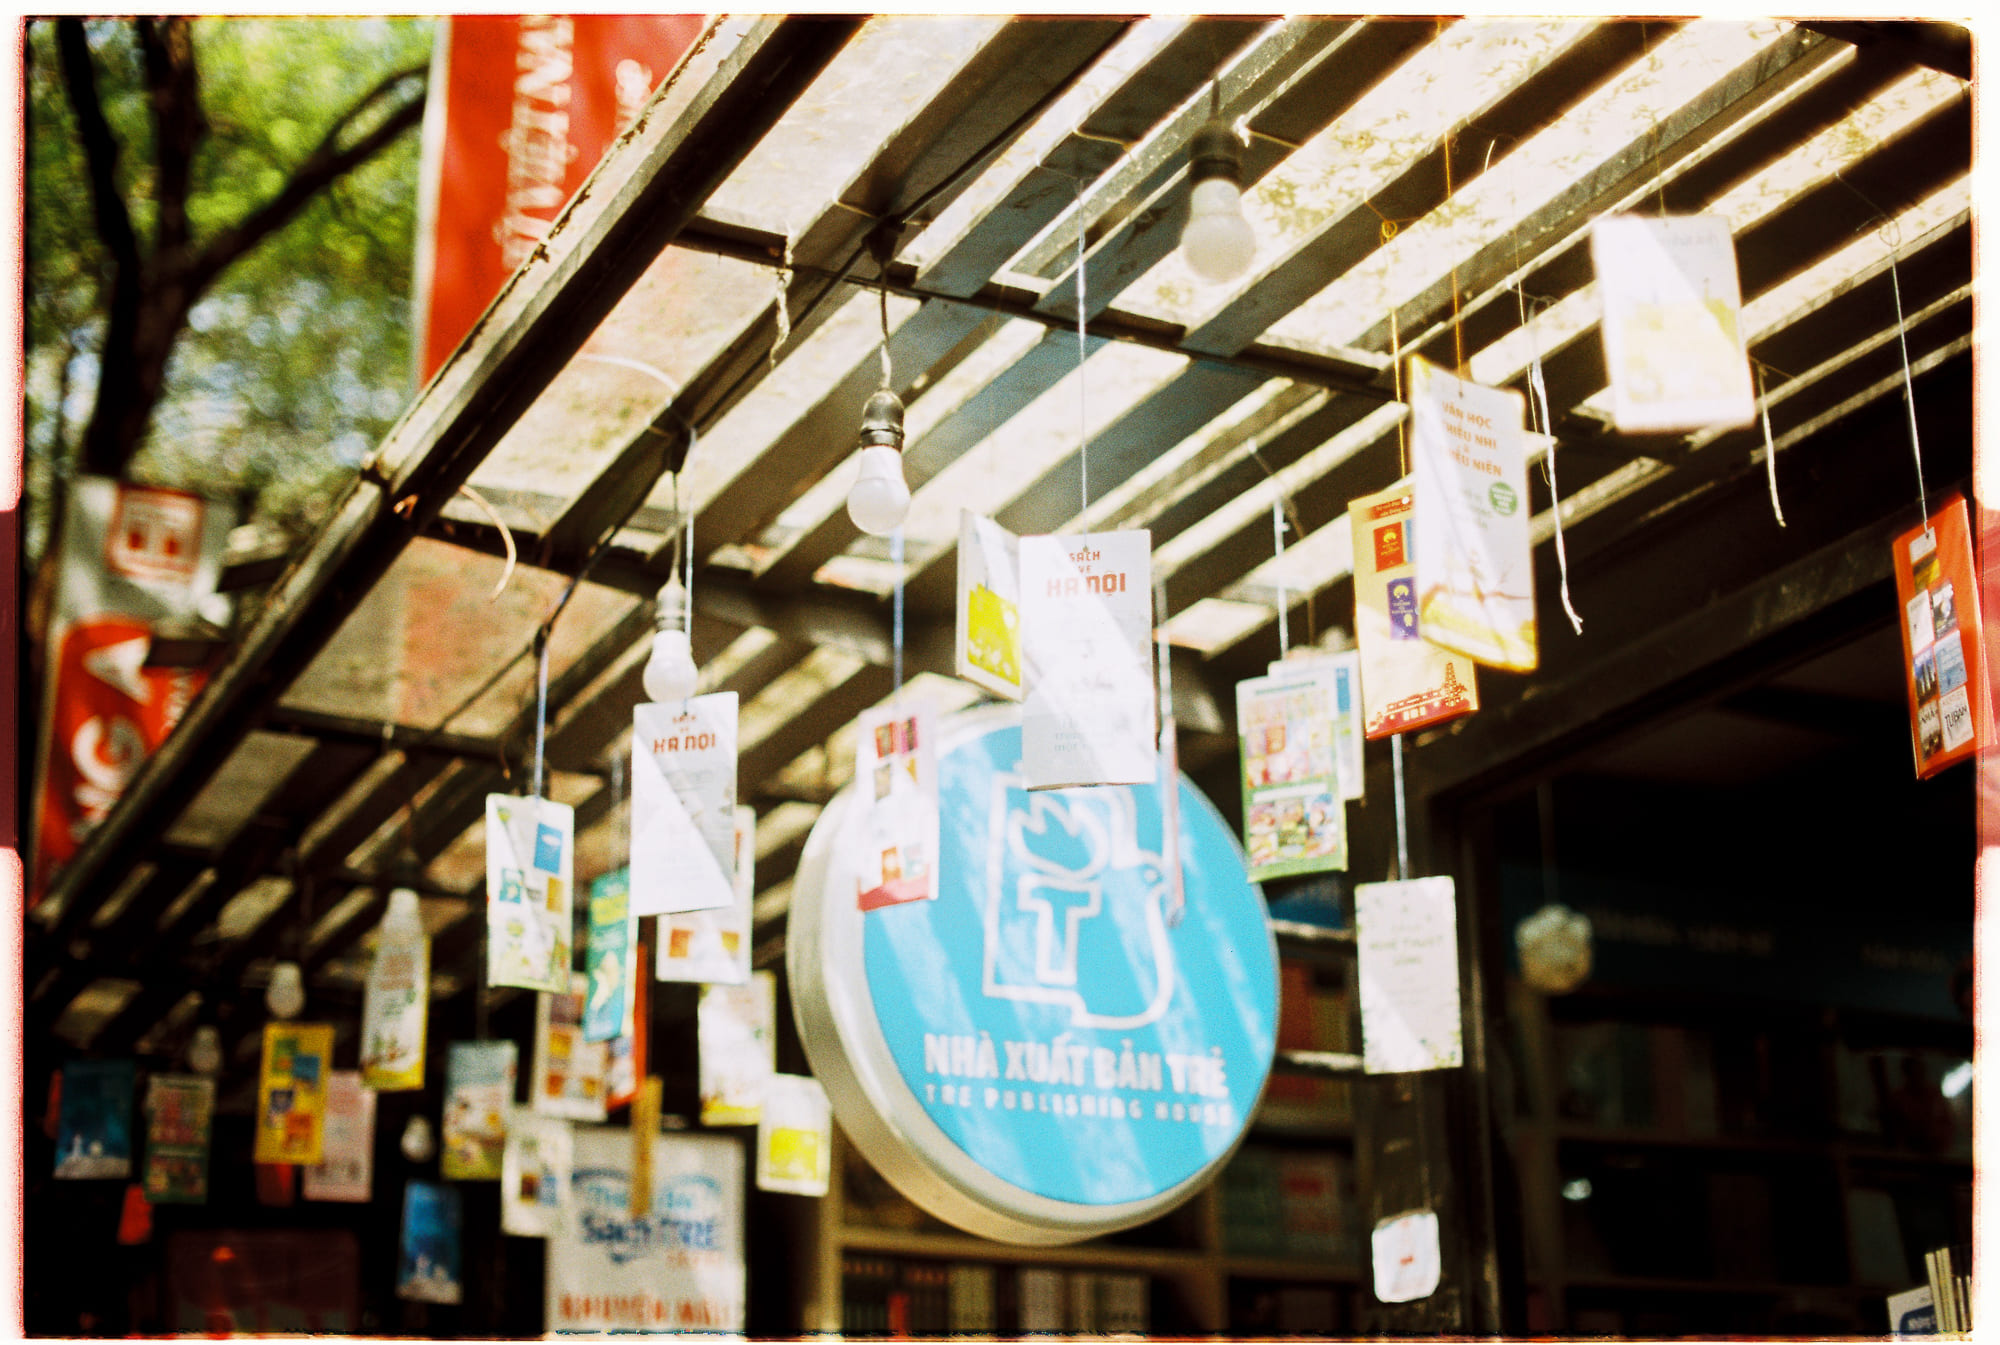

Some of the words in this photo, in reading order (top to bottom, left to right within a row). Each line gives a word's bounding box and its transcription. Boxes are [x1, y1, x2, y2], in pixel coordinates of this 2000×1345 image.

[924, 1030, 999, 1078] NHÀ
[1004, 1032, 1090, 1086] XUẤT
[1093, 1038, 1163, 1091] BẢN
[1166, 1045, 1230, 1098] TRẺ
[984, 1087, 1143, 1120] PUBLISHING
